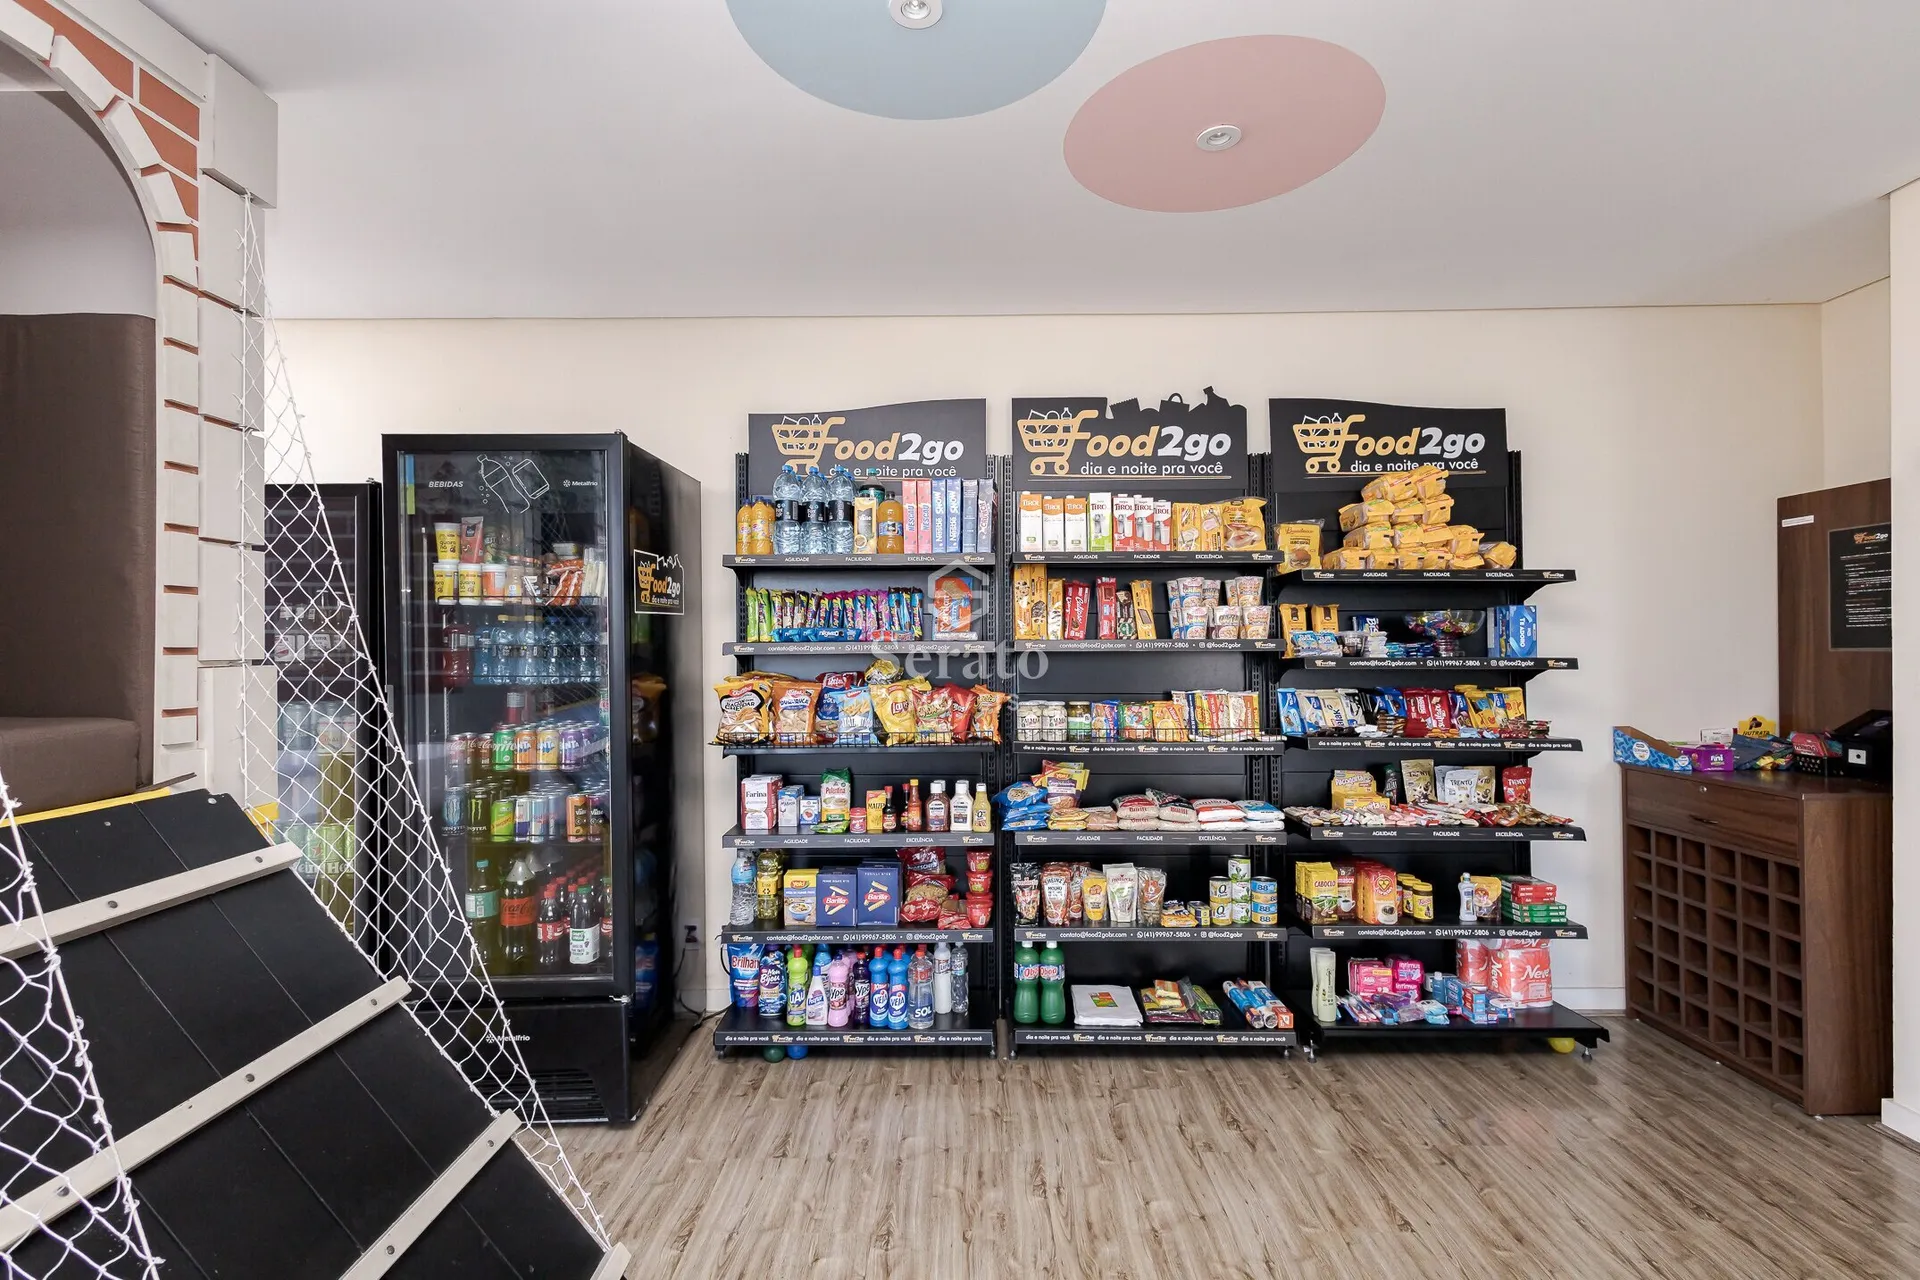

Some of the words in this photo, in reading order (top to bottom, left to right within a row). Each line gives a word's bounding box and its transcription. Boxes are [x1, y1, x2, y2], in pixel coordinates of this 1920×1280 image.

[854, 468, 862, 476] e
[902, 466, 924, 478] pra
[928, 465, 956, 477] você
[1080, 462, 1102, 475] dia
[1108, 466, 1116, 475] e
[1122, 462, 1157, 475] noite
[1162, 464, 1186, 476] pra
[1190, 460, 1224, 474] você
[1350, 459, 1370, 473] dia
[1374, 462, 1383, 472] e
[1387, 459, 1420, 472] noite
[1448, 458, 1479, 470] você
[933, 491, 944, 514] SNOW
[948, 490, 958, 514] SNOW
[907, 504, 915, 532] NESCAU
[922, 504, 930, 531] NESCAU
[1490, 956, 1502, 988] Neve
[1520, 964, 1550, 980] Neve
[789, 990, 806, 1004] UAU
[874, 994, 887, 1004] VEJA
[891, 998, 904, 1006] VEJA
[914, 1006, 932, 1018] SOL
